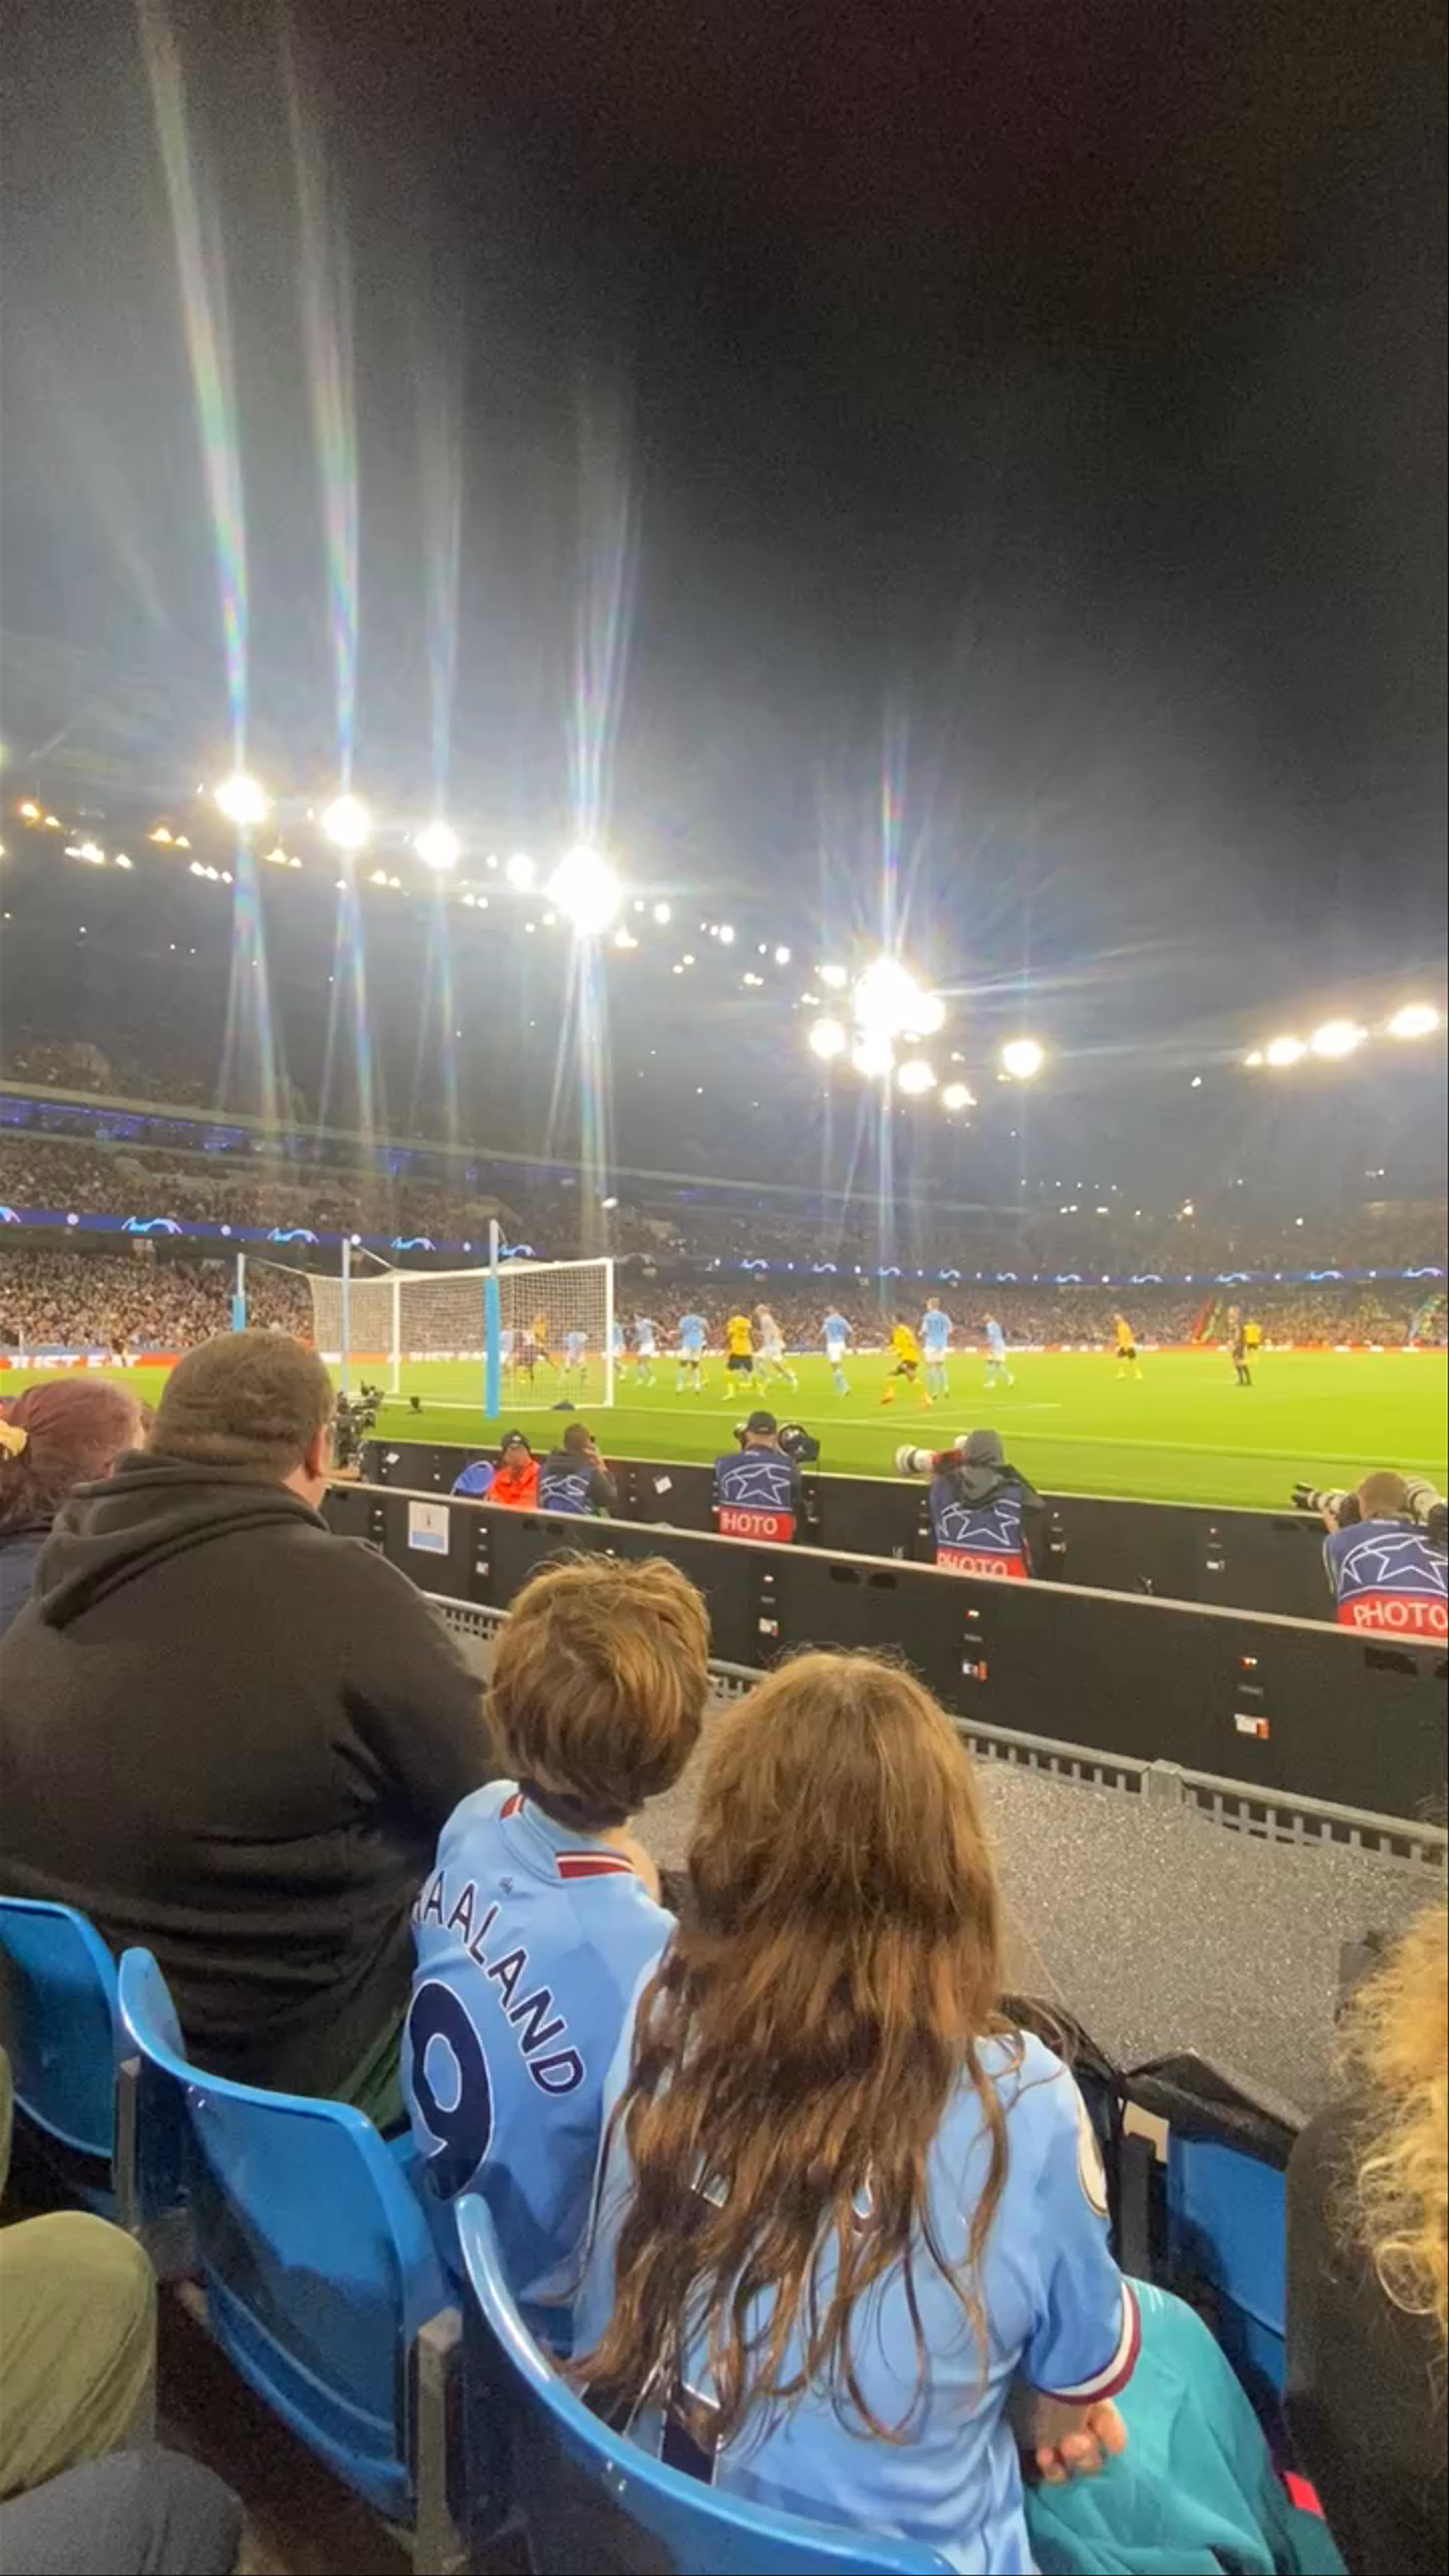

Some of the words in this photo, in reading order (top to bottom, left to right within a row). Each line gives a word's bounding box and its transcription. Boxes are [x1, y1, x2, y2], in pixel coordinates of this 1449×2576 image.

[1353, 1601, 1448, 1629] PHOTO
[407, 1979, 494, 2204] 9
[413, 1870, 586, 2096] AALAND
